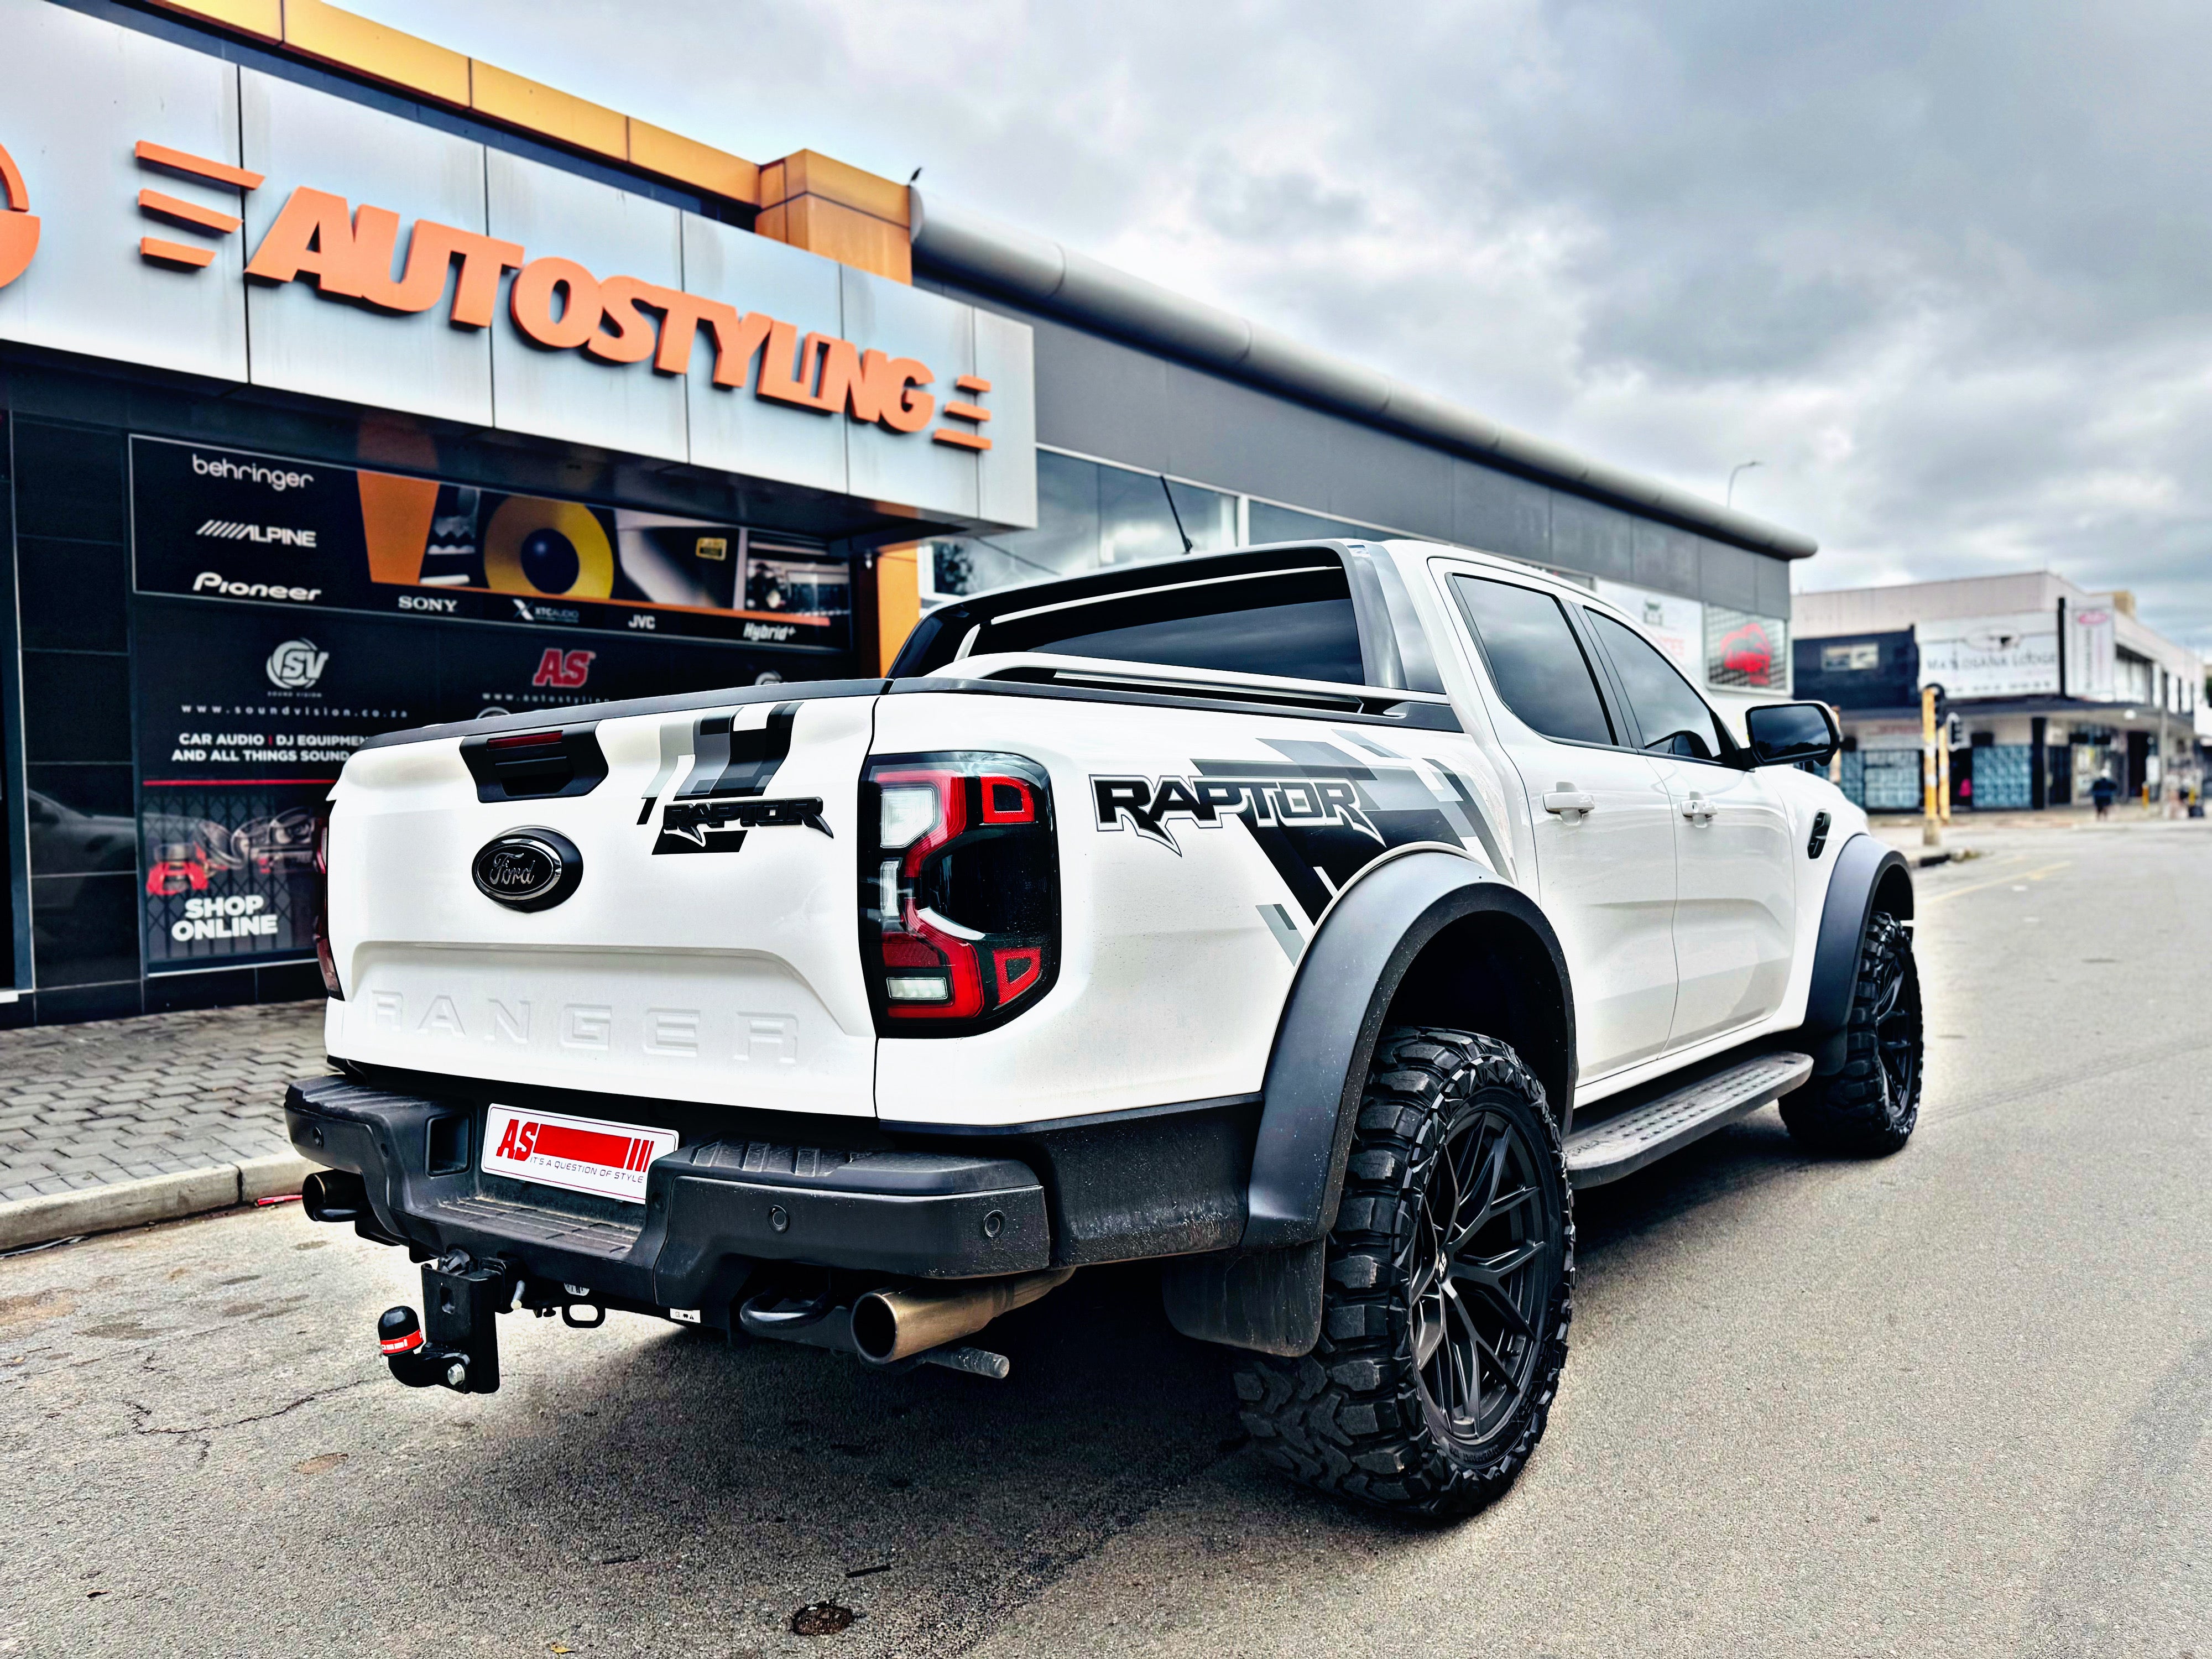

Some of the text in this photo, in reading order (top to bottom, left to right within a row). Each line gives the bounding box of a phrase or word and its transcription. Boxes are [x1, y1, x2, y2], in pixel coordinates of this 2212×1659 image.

[244, 186, 935, 432] AUTOSTYLING
[192, 454, 314, 491] behringer
[232, 522, 316, 547] ALPINE
[193, 572, 321, 601] Pioneer
[398, 596, 457, 612] SONY
[628, 614, 655, 629] JVC
[179, 733, 212, 745] CAR
[216, 734, 265, 745] AUDIO
[275, 734, 294, 746] DJ
[171, 749, 350, 762] AND ALL THINGS SOUND
[663, 796, 834, 843] RAPTOR
[1089, 774, 1387, 857] RAPTOR
[489, 852, 536, 885] Ford
[184, 895, 265, 920] SHOP
[171, 914, 278, 941] ONLINE
[372, 990, 799, 1064] RANGER
[496, 1119, 539, 1161] AS
[530, 1156, 544, 1166] IT'S
[554, 1161, 597, 1175] QUESTION
[599, 1168, 612, 1177] OF
[614, 1172, 644, 1183] STYLE
